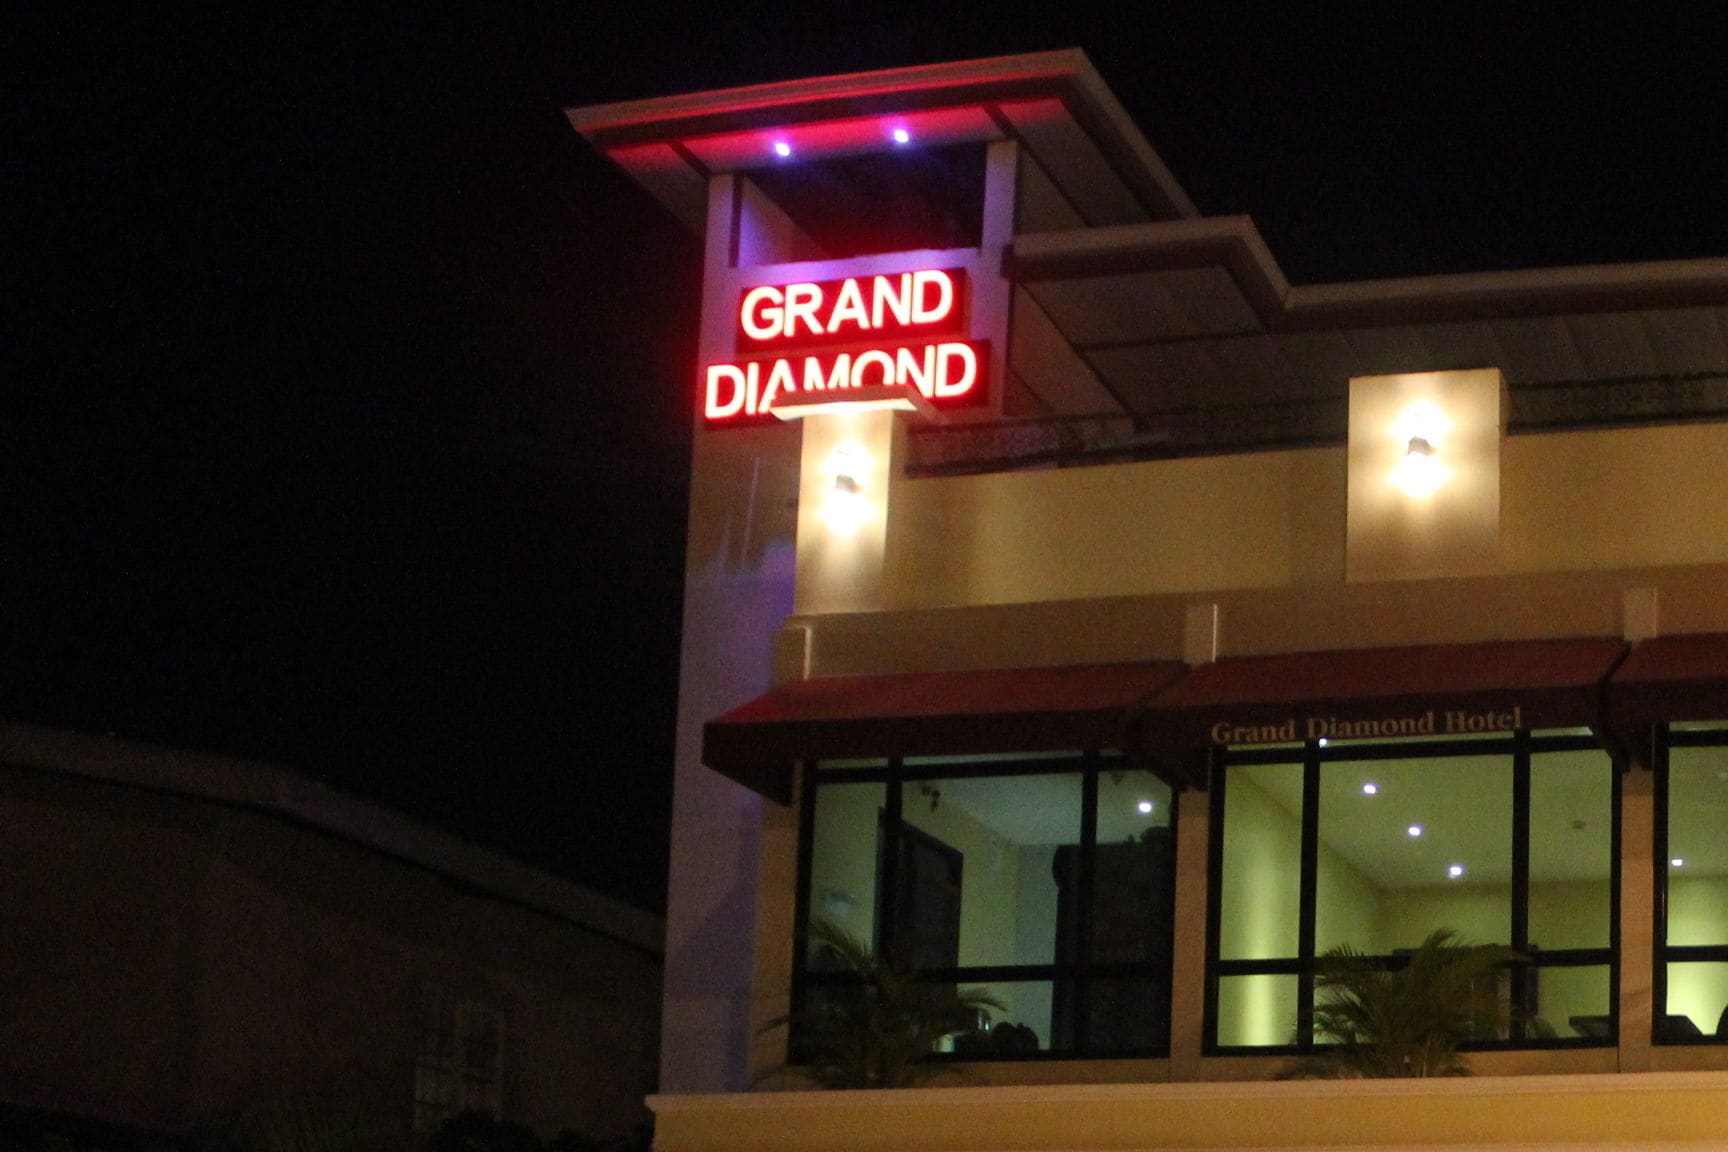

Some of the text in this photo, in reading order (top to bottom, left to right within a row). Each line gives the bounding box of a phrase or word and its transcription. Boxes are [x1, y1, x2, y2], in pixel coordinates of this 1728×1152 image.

[740, 269, 954, 341] GRAND
[704, 341, 978, 419] DIAMOND
[1210, 705, 1521, 743] Grand Diamond Hotel
